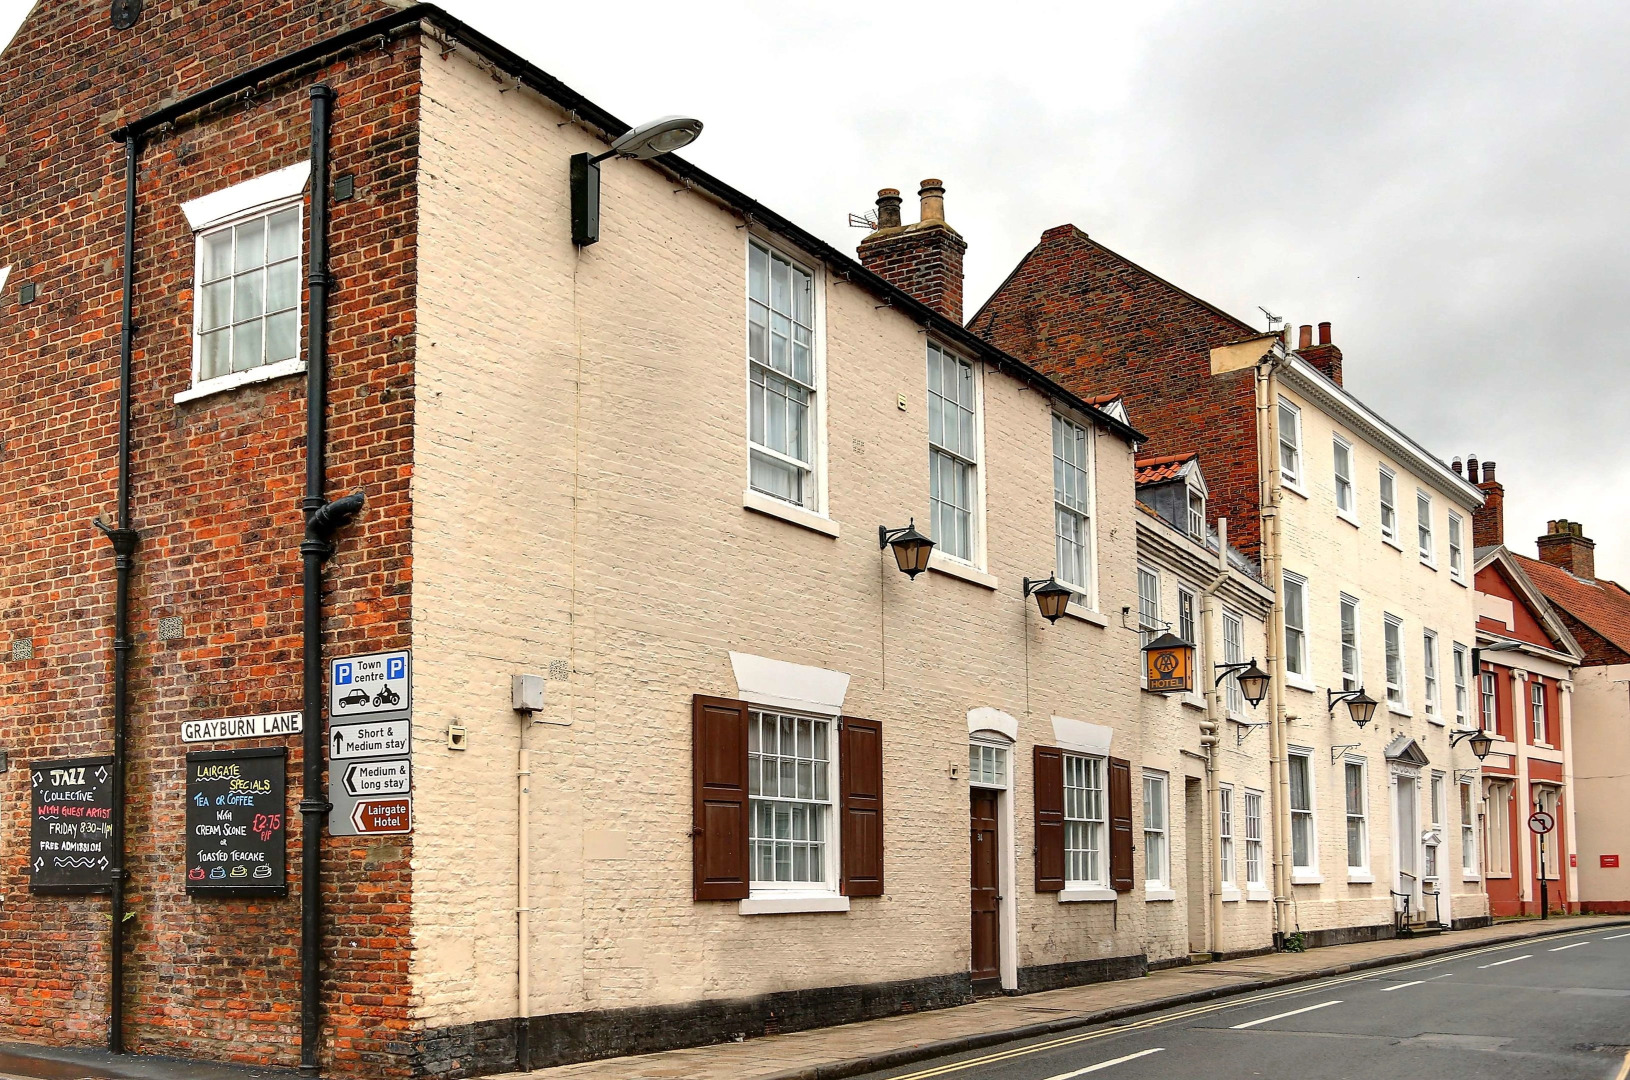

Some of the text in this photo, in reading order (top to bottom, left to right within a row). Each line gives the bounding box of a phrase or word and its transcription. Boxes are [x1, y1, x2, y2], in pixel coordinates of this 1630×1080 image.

[357, 660, 382, 671] Town
[390, 659, 403, 678] P
[339, 665, 350, 684] P
[354, 672, 385, 683] centre
[1151, 679, 1182, 688] HOTEL
[185, 714, 299, 739] GRAYBURN LANE
[357, 726, 394, 739] Short &
[346, 738, 406, 752] Medium stay
[50, 767, 86, 786] JAZZ
[197, 764, 240, 777] LAIRGATE
[360, 765, 406, 777] Medium &
[229, 778, 271, 791] SPECIALS
[361, 778, 404, 790] long stay
[194, 792, 255, 807] TEA OR COFFEE
[38, 804, 112, 819] WITH GUEST ARTIST
[368, 803, 406, 816] Lairgate
[252, 813, 281, 833] £2.75
[374, 816, 401, 827] Hotel
[49, 822, 78, 839] FRIDAY
[195, 823, 247, 836] CREAM SCONE
[40, 840, 102, 853] FREE ADMISSION
[196, 849, 265, 862] TOASTED TEACAKE
